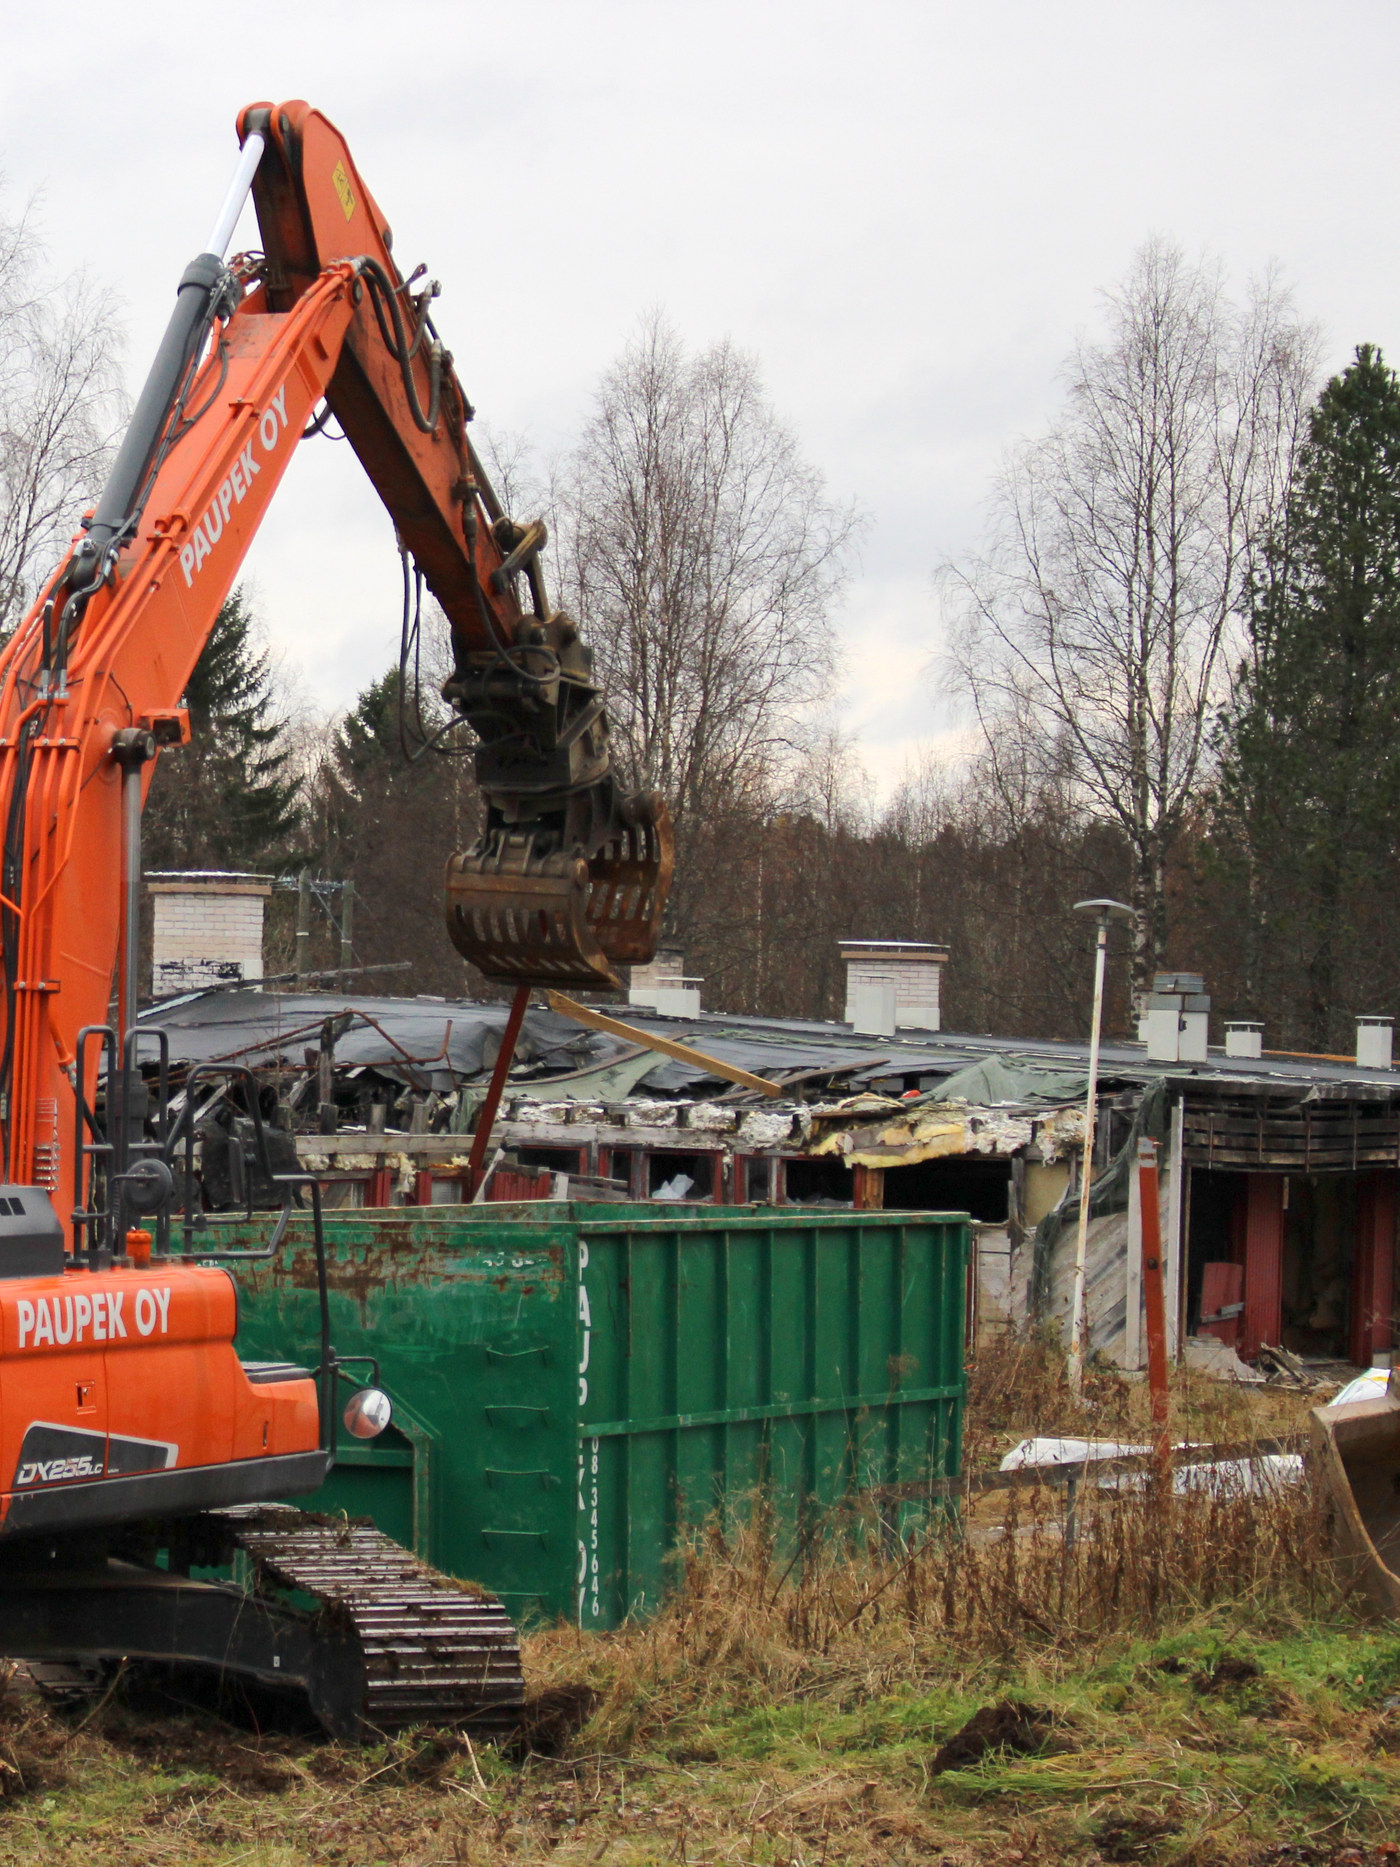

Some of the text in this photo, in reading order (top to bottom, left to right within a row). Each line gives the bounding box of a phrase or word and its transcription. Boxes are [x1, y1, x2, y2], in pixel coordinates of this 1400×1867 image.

[179, 383, 289, 588] PAUPEK OY
[17, 1287, 171, 1349] PAUPEK OY
